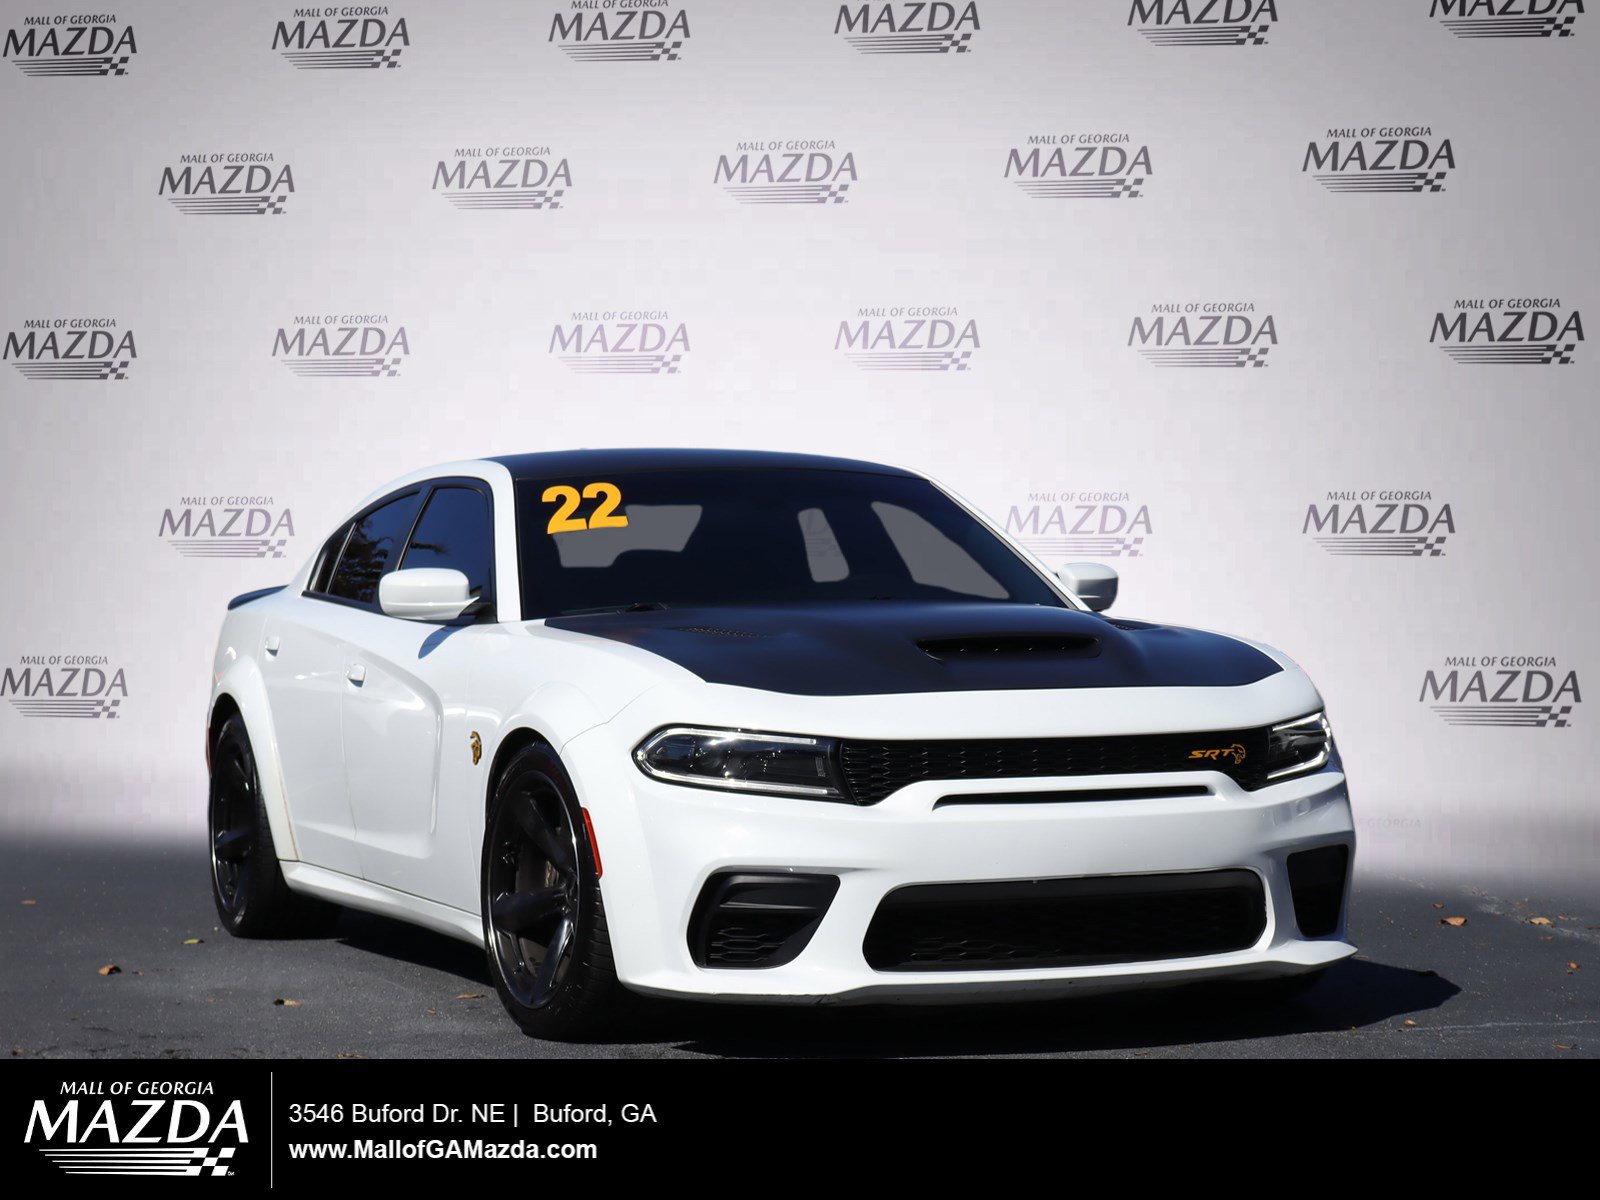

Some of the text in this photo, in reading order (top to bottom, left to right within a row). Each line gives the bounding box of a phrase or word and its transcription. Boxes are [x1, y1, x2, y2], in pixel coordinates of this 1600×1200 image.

[292, 5, 389, 18] MALL OF GEORGIA
[570, 0, 669, 10] MALL OF GEORGIA
[833, 0, 981, 35] MAZDA
[1126, 0, 1279, 27] MAZDA
[23, 13, 117, 26] MALL OF GEORGIA
[547, 8, 691, 43] MAZDA
[2, 25, 138, 58] MAZDA
[271, 17, 411, 51] MAZDA
[735, 139, 836, 152] MALL OF GEORGIA
[1026, 132, 1130, 145] MALL OF GEORGIA
[1326, 126, 1432, 139] MALL OF GEORGIA
[179, 152, 274, 164] MALL OF GEORGIA
[453, 145, 551, 158] MALL OF GEORGIA
[1003, 145, 1154, 179] MAZDA
[1301, 138, 1456, 173] MAZDA
[157, 163, 296, 196] MAZDA
[431, 157, 573, 191] MAZDA
[712, 151, 858, 185] MAZDA
[570, 310, 669, 322] MALL OF GEORGIA
[857, 306, 959, 318] MALL OF GEORGIA
[1151, 302, 1255, 314] MALL OF GEORGIA
[1453, 297, 1561, 310] MALL OF GEORGIA
[23, 317, 117, 329] MALL OF GEORGIA
[293, 314, 389, 326] MALL OF GEORGIA
[1127, 314, 1279, 347] MAZDA
[1428, 310, 1586, 344] MAZDA
[2, 329, 138, 361] MAZDA
[271, 326, 411, 358] MAZDA
[547, 322, 691, 354] MAZDA
[833, 318, 982, 351] MAZDA
[179, 495, 274, 506] MALL OF GEORGIA
[541, 482, 629, 535] 22
[1027, 491, 1130, 503] MALL OF GEORGIA
[1326, 490, 1432, 502] MALL OF GEORGIA
[157, 507, 296, 538] MAZDA
[1005, 503, 1154, 536] MAZDA
[1301, 503, 1456, 535] MAZDA
[19, 655, 109, 666] MALL OF GEORGIA
[1444, 655, 1557, 668] MALL OF GEORGIA
[0, 667, 129, 697] MAZDA
[1418, 669, 1583, 704] MAZDA
[1187, 748, 1235, 760] SRT
